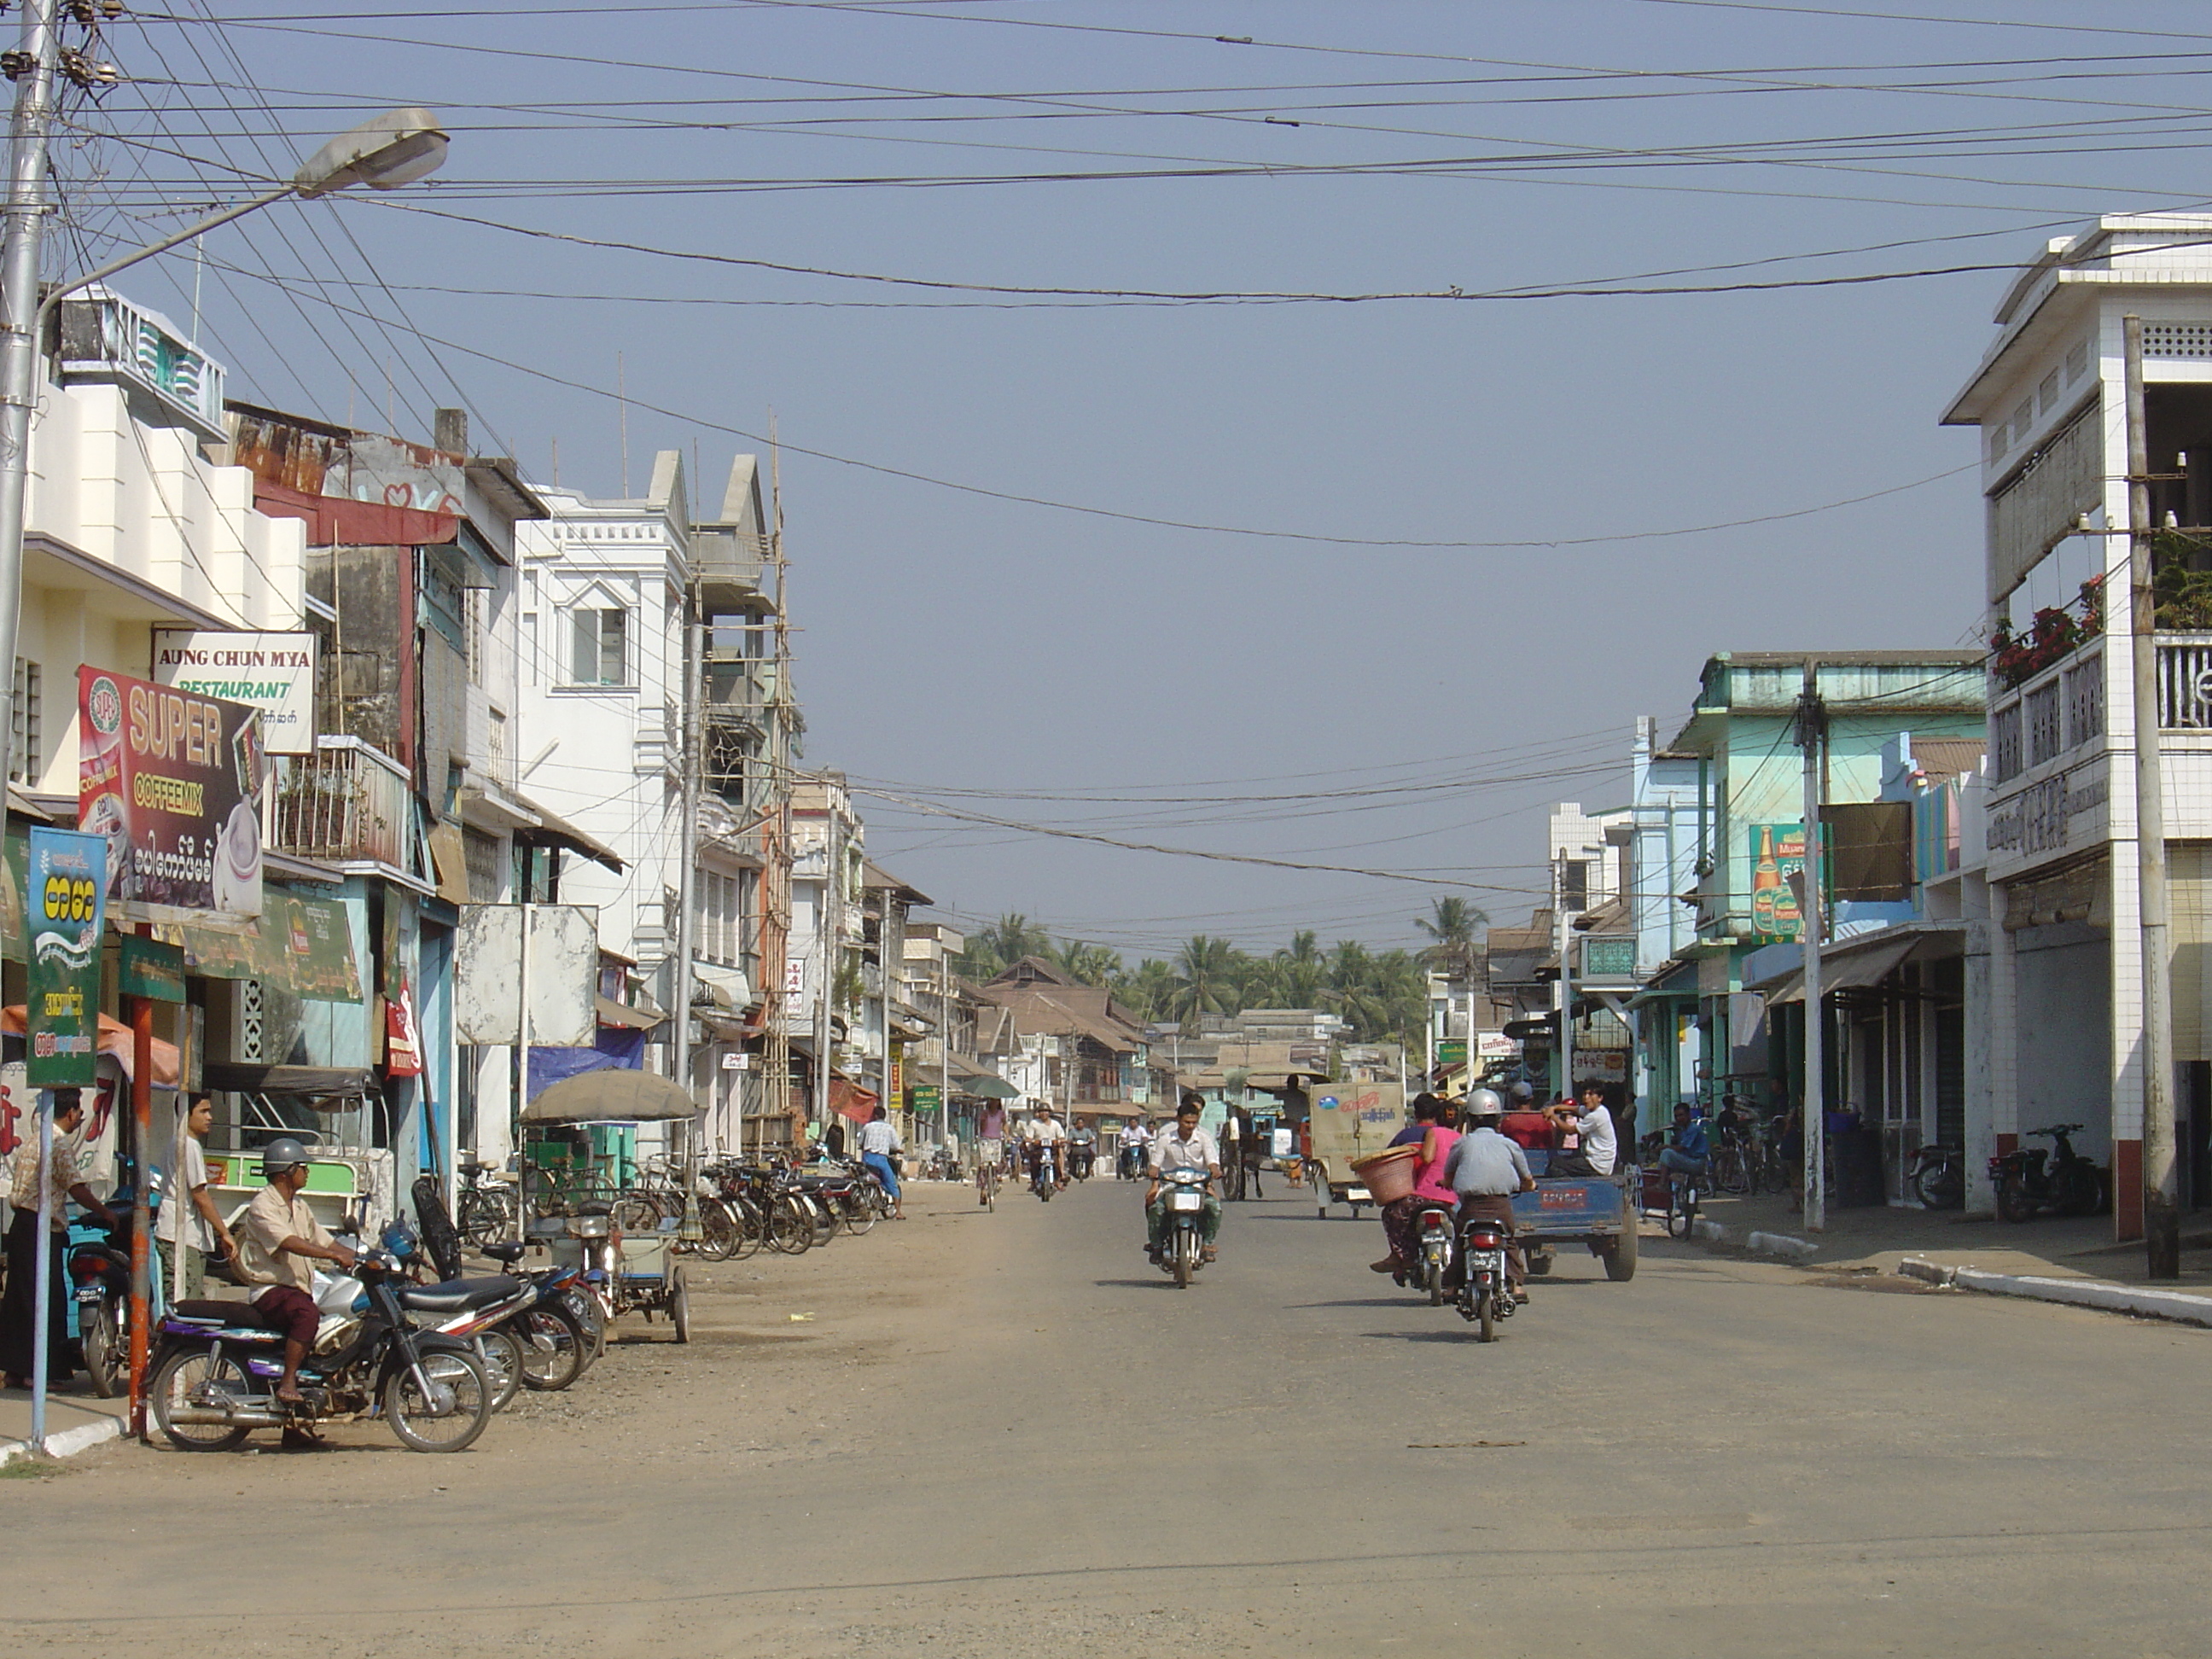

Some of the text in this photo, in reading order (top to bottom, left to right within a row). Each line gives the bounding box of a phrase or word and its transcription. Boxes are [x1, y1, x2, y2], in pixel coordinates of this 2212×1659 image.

[159, 649, 310, 667] AUNG CHUN MYA
[130, 684, 222, 770] SUPER
[134, 771, 203, 817] COFFEEMIX
